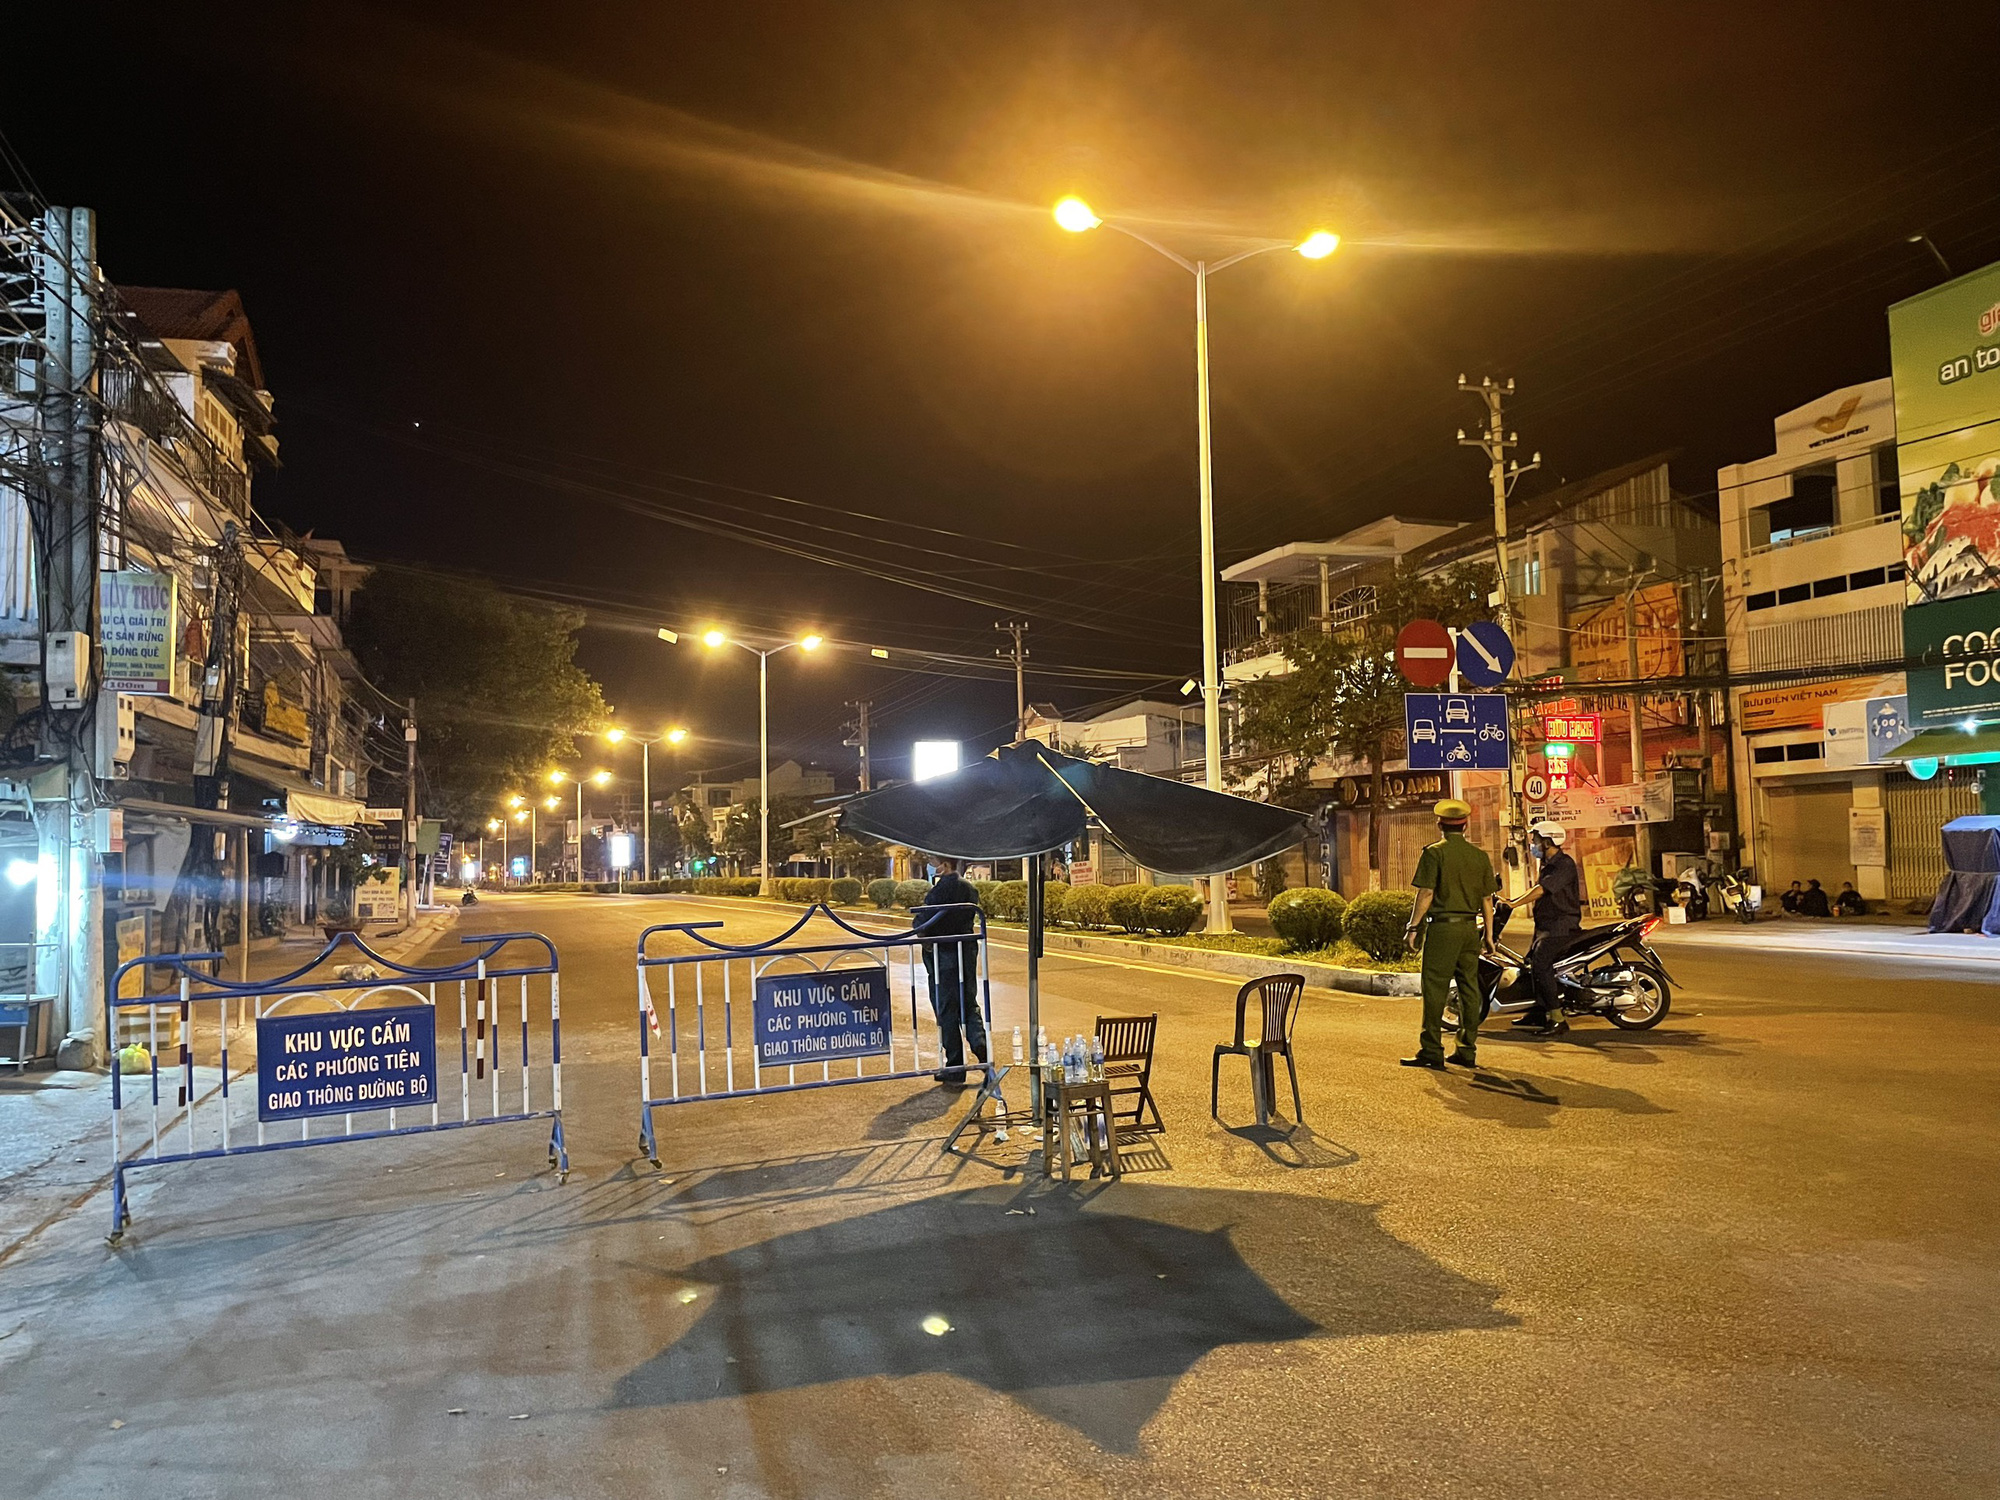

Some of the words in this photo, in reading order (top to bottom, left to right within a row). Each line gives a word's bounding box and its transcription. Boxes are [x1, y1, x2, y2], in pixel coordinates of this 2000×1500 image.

[1940, 358, 1969, 382] an
[129, 613, 148, 627] GIẢI
[151, 615, 167, 627] TRÍ
[115, 628, 135, 641] SẢN
[137, 630, 164, 642] RỪNG
[140, 646, 159, 659] QUÊ
[1743, 698, 1764, 708] BƯU
[1764, 693, 1789, 706] ĐIỆN
[1790, 690, 1813, 703] VIỆT
[1814, 688, 1838, 698] NAM
[1407, 775, 1442, 795] ANH
[1530, 781, 1543, 795] 40
[773, 988, 801, 1008] KHU
[808, 984, 835, 1007] VỰC
[841, 977, 871, 1001] CẤM
[767, 1013, 791, 1032] CÁC
[798, 1010, 847, 1030] PHƯƠNG
[852, 1006, 878, 1025] TIỆN
[285, 1031, 322, 1054] KHU
[329, 1026, 365, 1053] VỰC
[371, 1017, 411, 1046] CẤM
[764, 1040, 789, 1057] GIAO
[792, 1034, 827, 1054] THÔNG
[830, 1030, 867, 1049] ĐƯỜNG
[870, 1027, 884, 1047] BỘ
[276, 1060, 308, 1081] CÁC
[315, 1055, 379, 1077] PHƯƠNG
[384, 1049, 420, 1072] TIỆN
[268, 1091, 301, 1110] GIAO
[306, 1084, 353, 1106] THÔNG
[358, 1078, 405, 1100] ĐƯỜNG
[410, 1074, 428, 1097] BỘ
